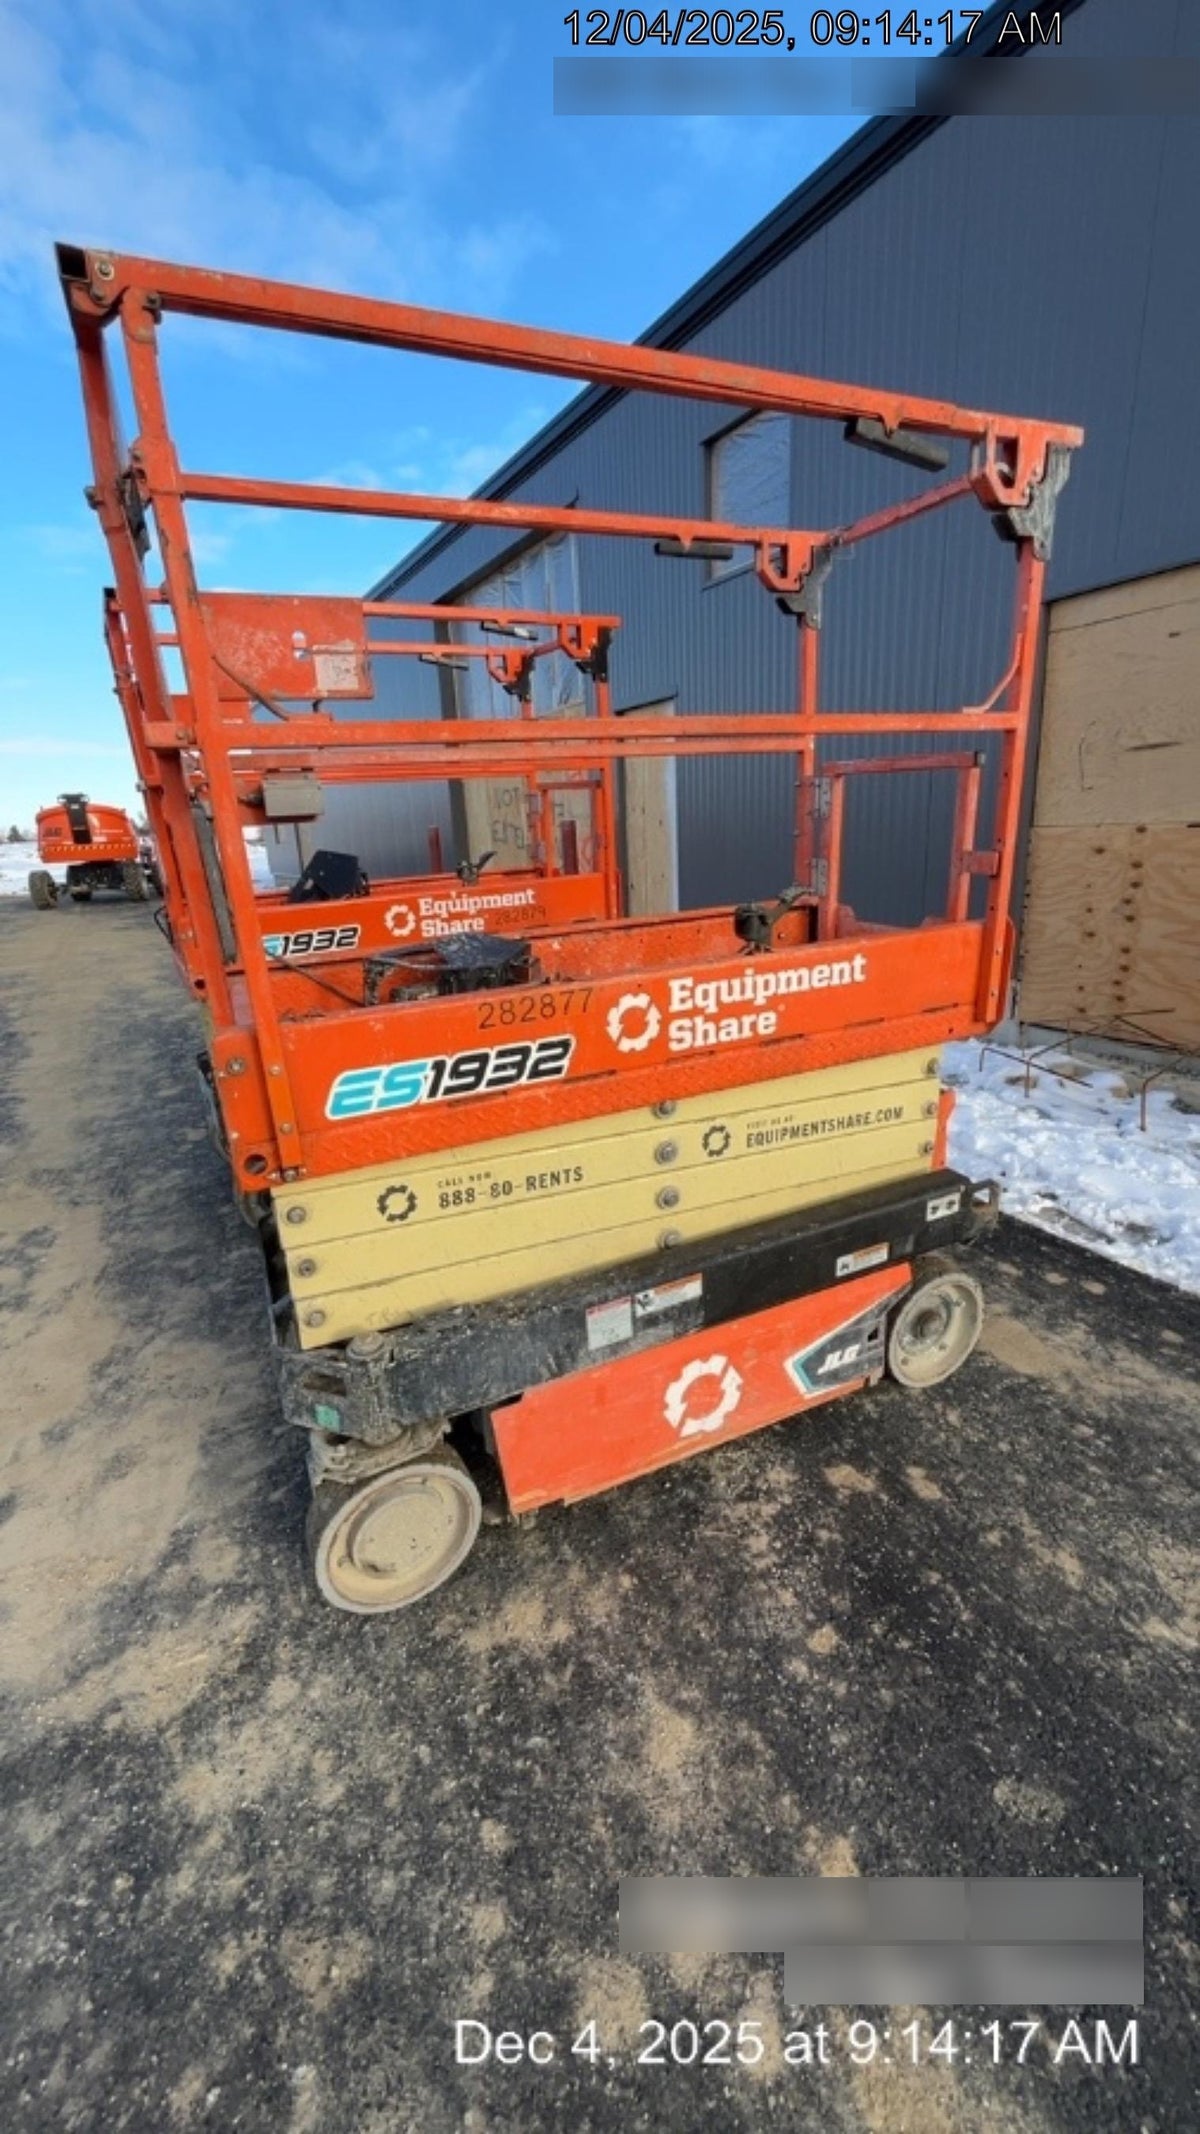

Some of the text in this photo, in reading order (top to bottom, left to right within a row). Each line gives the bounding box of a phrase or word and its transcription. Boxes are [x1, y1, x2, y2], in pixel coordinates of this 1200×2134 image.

[418, 889, 535, 918] Equipment
[262, 926, 361, 958] S1932
[421, 916, 485, 939] Share
[668, 953, 867, 1013] Equipment
[478, 988, 593, 1030] 282877
[668, 1010, 777, 1051] Share
[327, 1036, 574, 1118] ES1932
[746, 1107, 904, 1148] EQUIPMENTSHARE.COM
[437, 1178, 464, 1189] CALL
[438, 1166, 584, 1209] 888-80-RENTS
[817, 1343, 861, 1376] JLG
